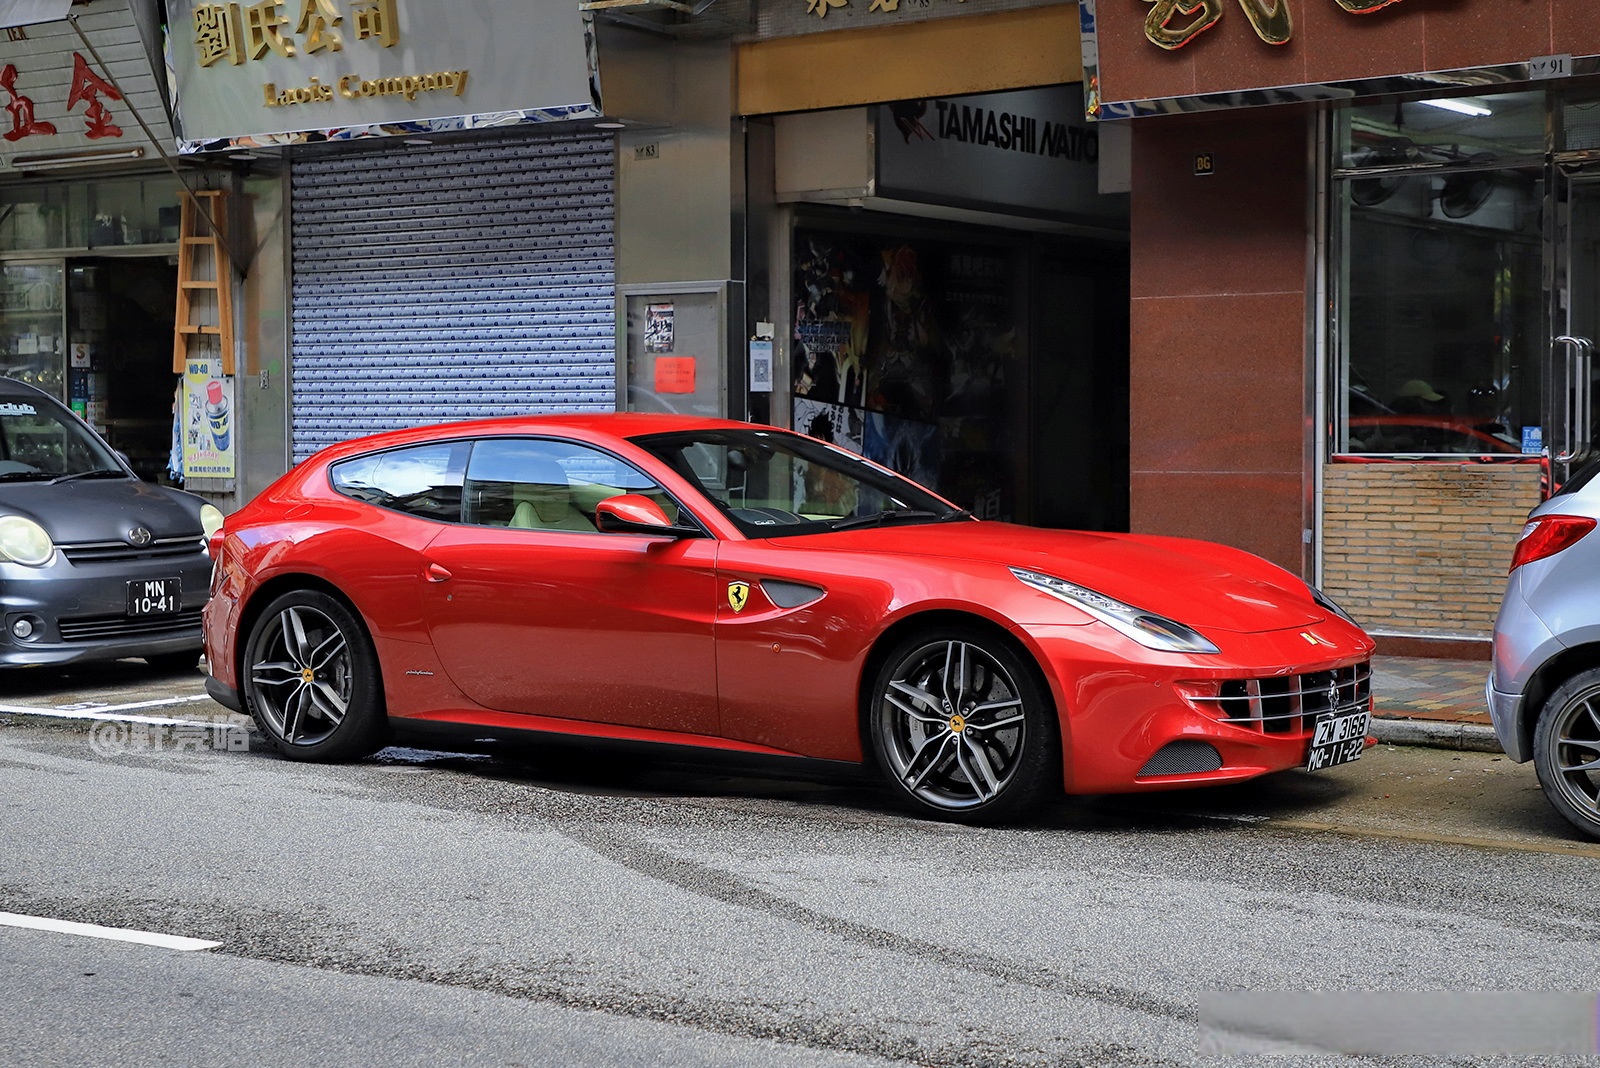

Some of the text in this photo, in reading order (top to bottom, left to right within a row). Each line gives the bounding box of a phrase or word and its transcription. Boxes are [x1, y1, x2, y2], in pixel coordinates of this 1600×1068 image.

[192, 0, 399, 67] 劉氏公司
[1550, 58, 1564, 75] 91
[263, 70, 469, 107] Laois Company
[935, 100, 1036, 154] TAMASHII
[646, 145, 655, 157] 83
[189, 364, 208, 375] WD-40
[209, 415, 229, 429] WD-4
[145, 580, 165, 597] MN
[134, 595, 174, 614] 10-41
[1339, 714, 1367, 740] 3168
[1306, 738, 1365, 773] MQ-11-22
